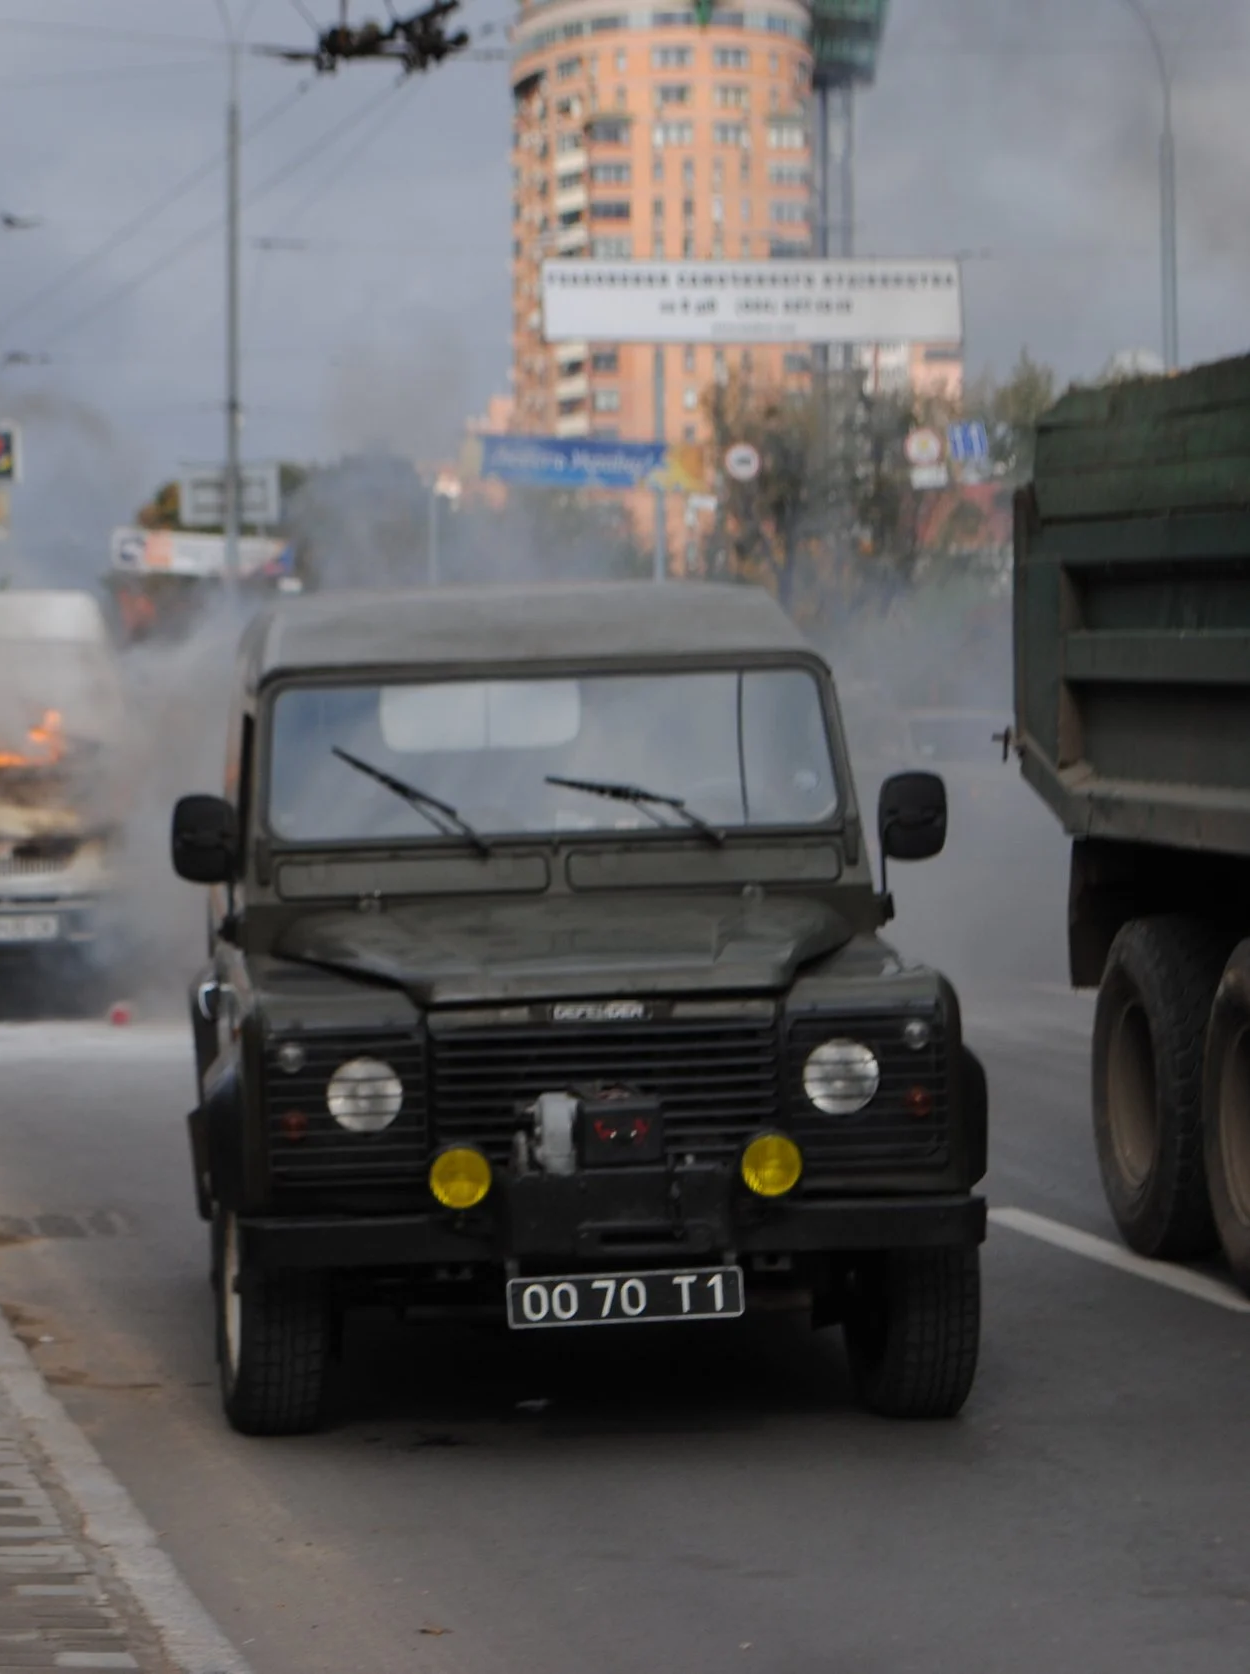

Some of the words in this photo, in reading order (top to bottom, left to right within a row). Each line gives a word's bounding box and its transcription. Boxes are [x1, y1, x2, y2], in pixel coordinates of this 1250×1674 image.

[522, 1282, 579, 1322] 00
[591, 1277, 647, 1318] 70
[671, 1272, 725, 1313] T1
